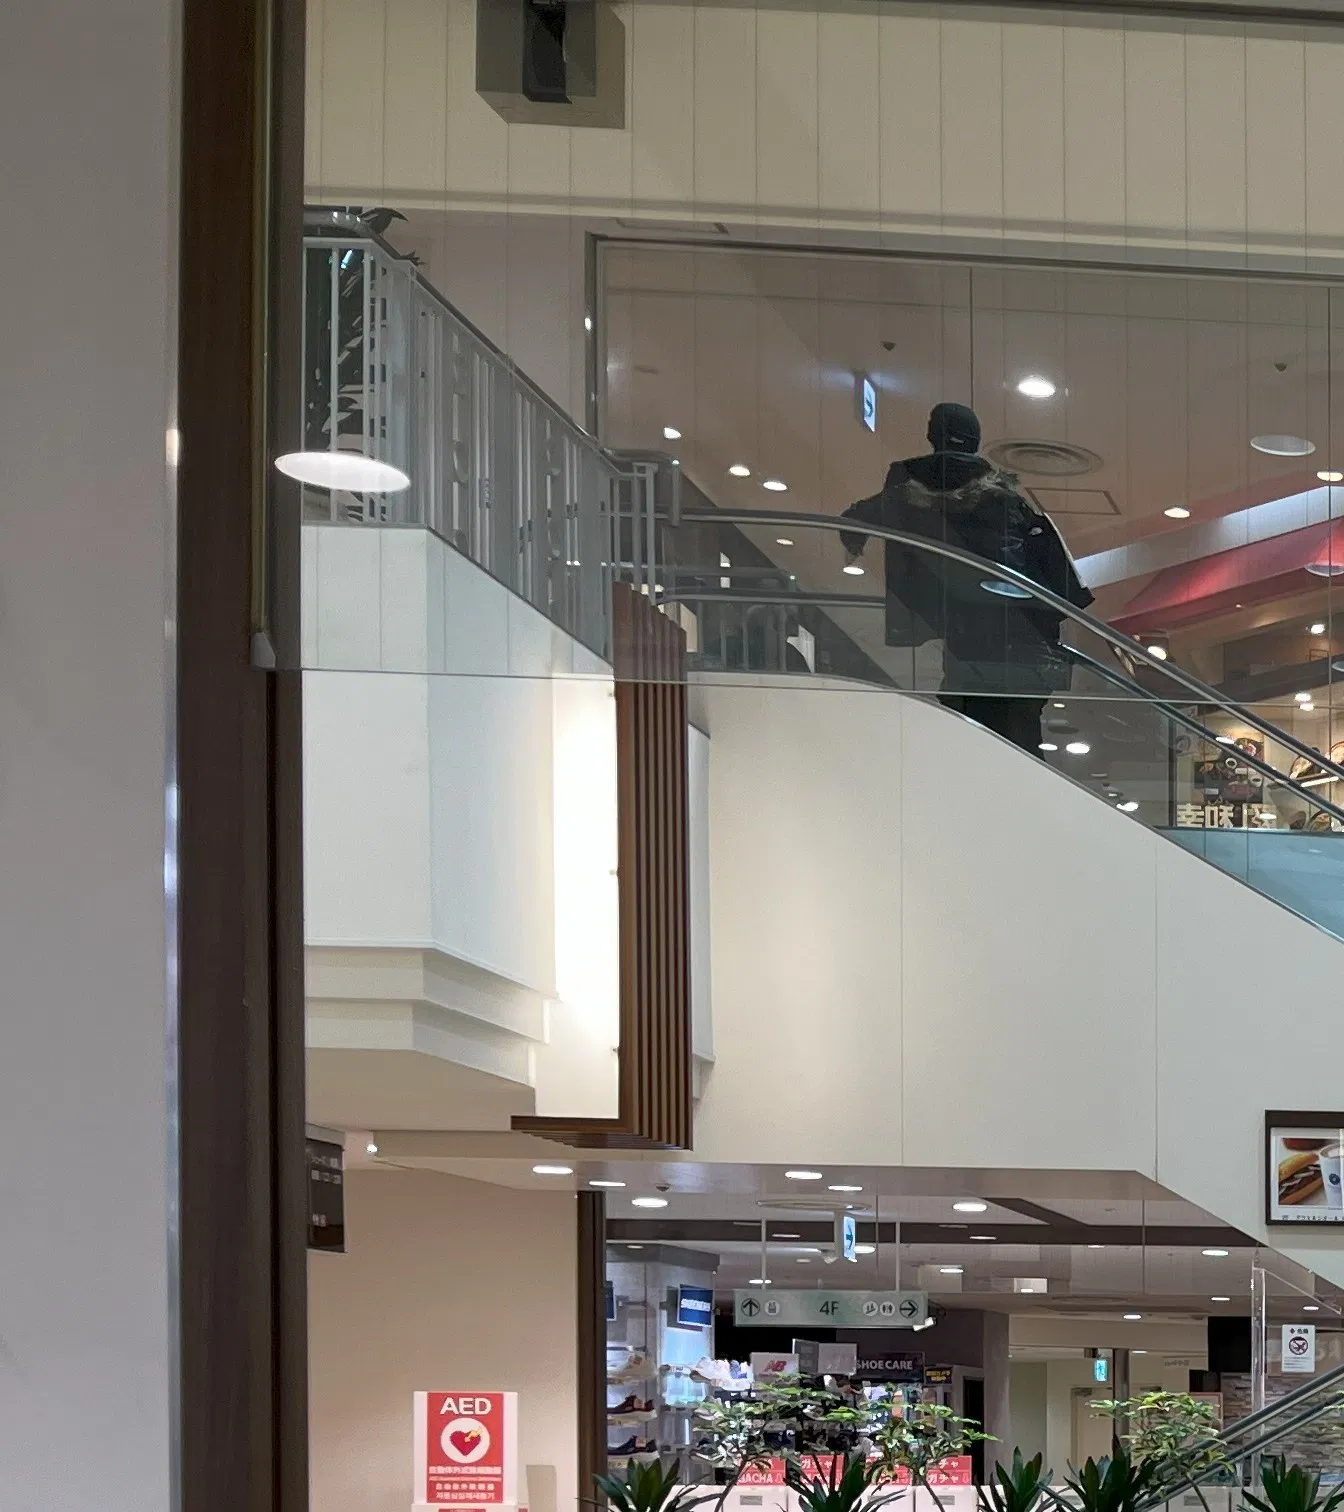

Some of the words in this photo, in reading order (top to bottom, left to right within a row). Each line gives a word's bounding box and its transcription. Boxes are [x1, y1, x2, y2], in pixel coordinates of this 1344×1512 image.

[819, 1301, 839, 1316] 4F
[857, 1360, 883, 1370] SHOE
[884, 1360, 913, 1370] CARE
[440, 1397, 492, 1415] AED
[927, 1474, 959, 1483] ガチャ
